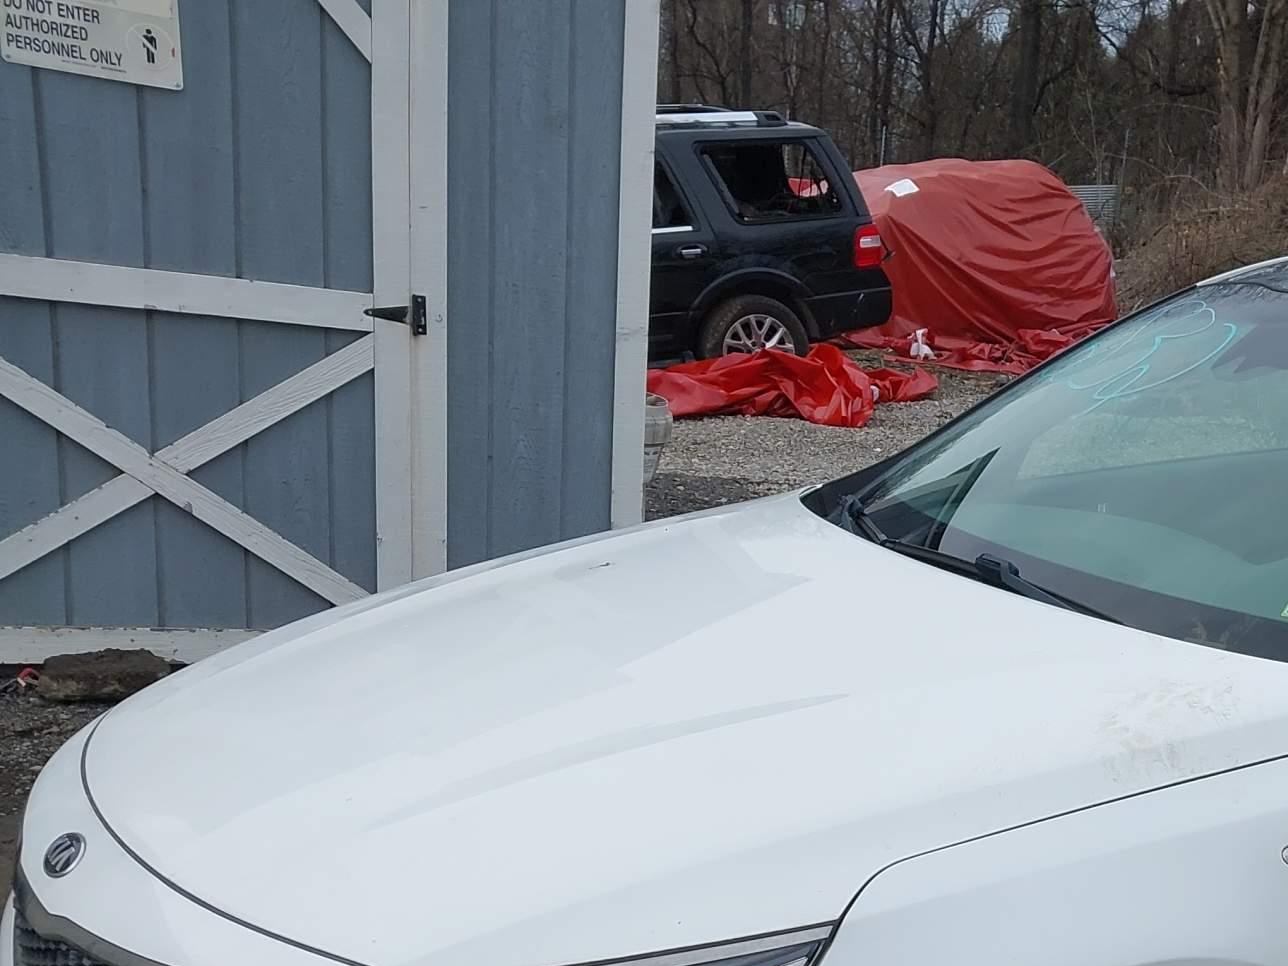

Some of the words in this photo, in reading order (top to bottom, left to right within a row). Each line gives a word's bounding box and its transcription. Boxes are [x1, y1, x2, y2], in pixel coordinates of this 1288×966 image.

[26, 0, 53, 16] NOT
[57, 3, 101, 24] ENTER
[5, 13, 89, 41] AUTHORIZED
[6, 33, 87, 61] PERSONNEL
[90, 47, 123, 67] ONLY
